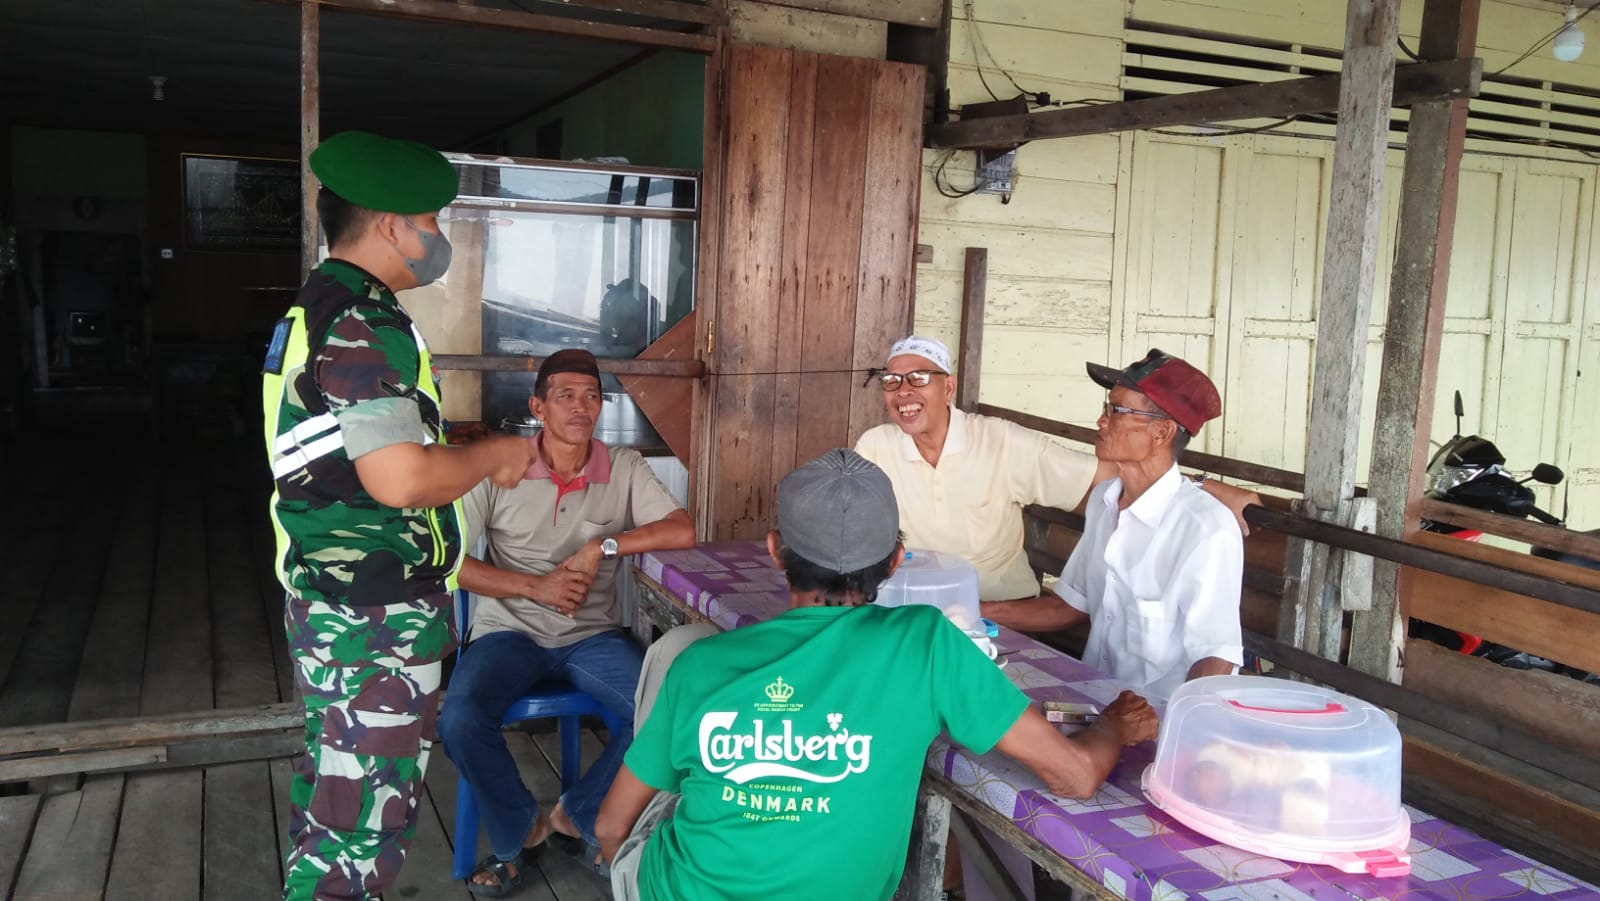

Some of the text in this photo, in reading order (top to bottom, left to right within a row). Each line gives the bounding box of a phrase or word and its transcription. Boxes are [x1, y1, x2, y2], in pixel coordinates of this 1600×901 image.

[698, 711, 873, 774] Carlsberg
[722, 786, 831, 814] DENMARK
[748, 783, 803, 793] COPENHAGEN
